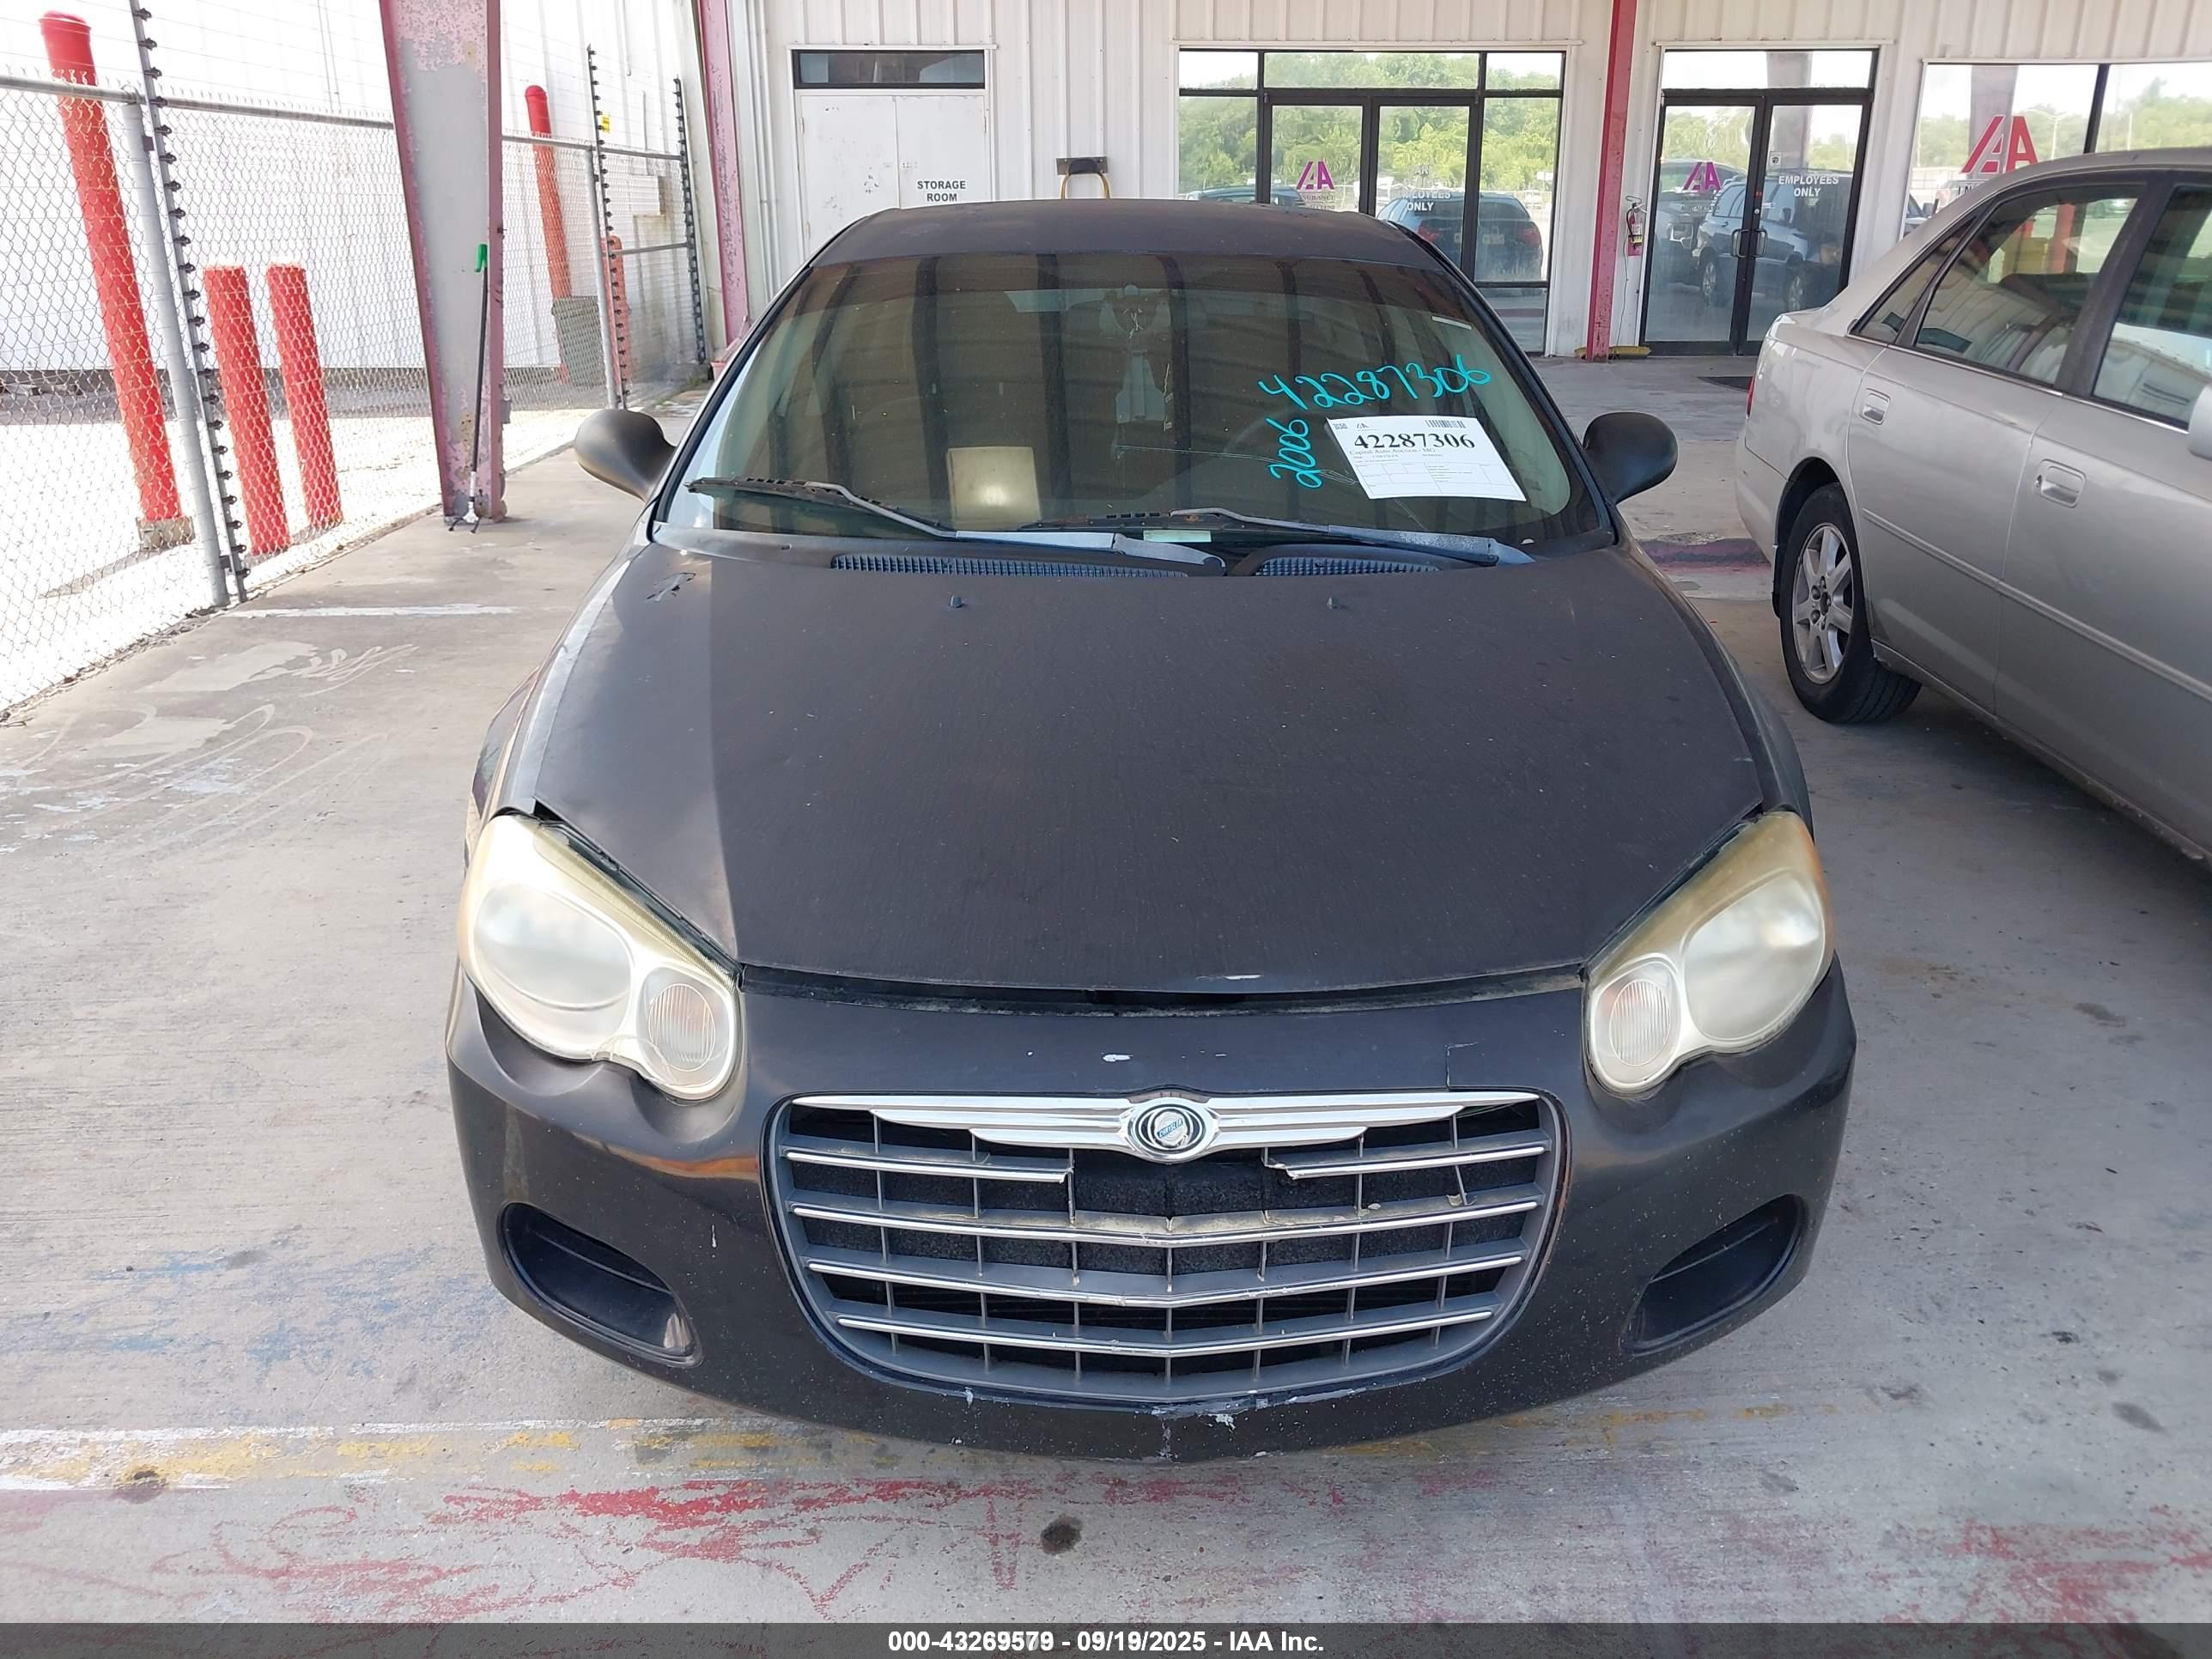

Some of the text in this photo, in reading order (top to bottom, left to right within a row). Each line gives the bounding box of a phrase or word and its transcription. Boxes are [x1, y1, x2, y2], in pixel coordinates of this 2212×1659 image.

[917, 180, 966, 190] STORAGE
[1778, 175, 1839, 185] EMPLOYEES
[927, 192, 957, 202] ROOM
[1794, 187, 1820, 198] ONLY
[1407, 202, 1434, 211] ONLY
[1257, 353, 1492, 410] 42287306
[1354, 433, 1476, 449] 42287306
[1264, 416, 1324, 489] 2006
